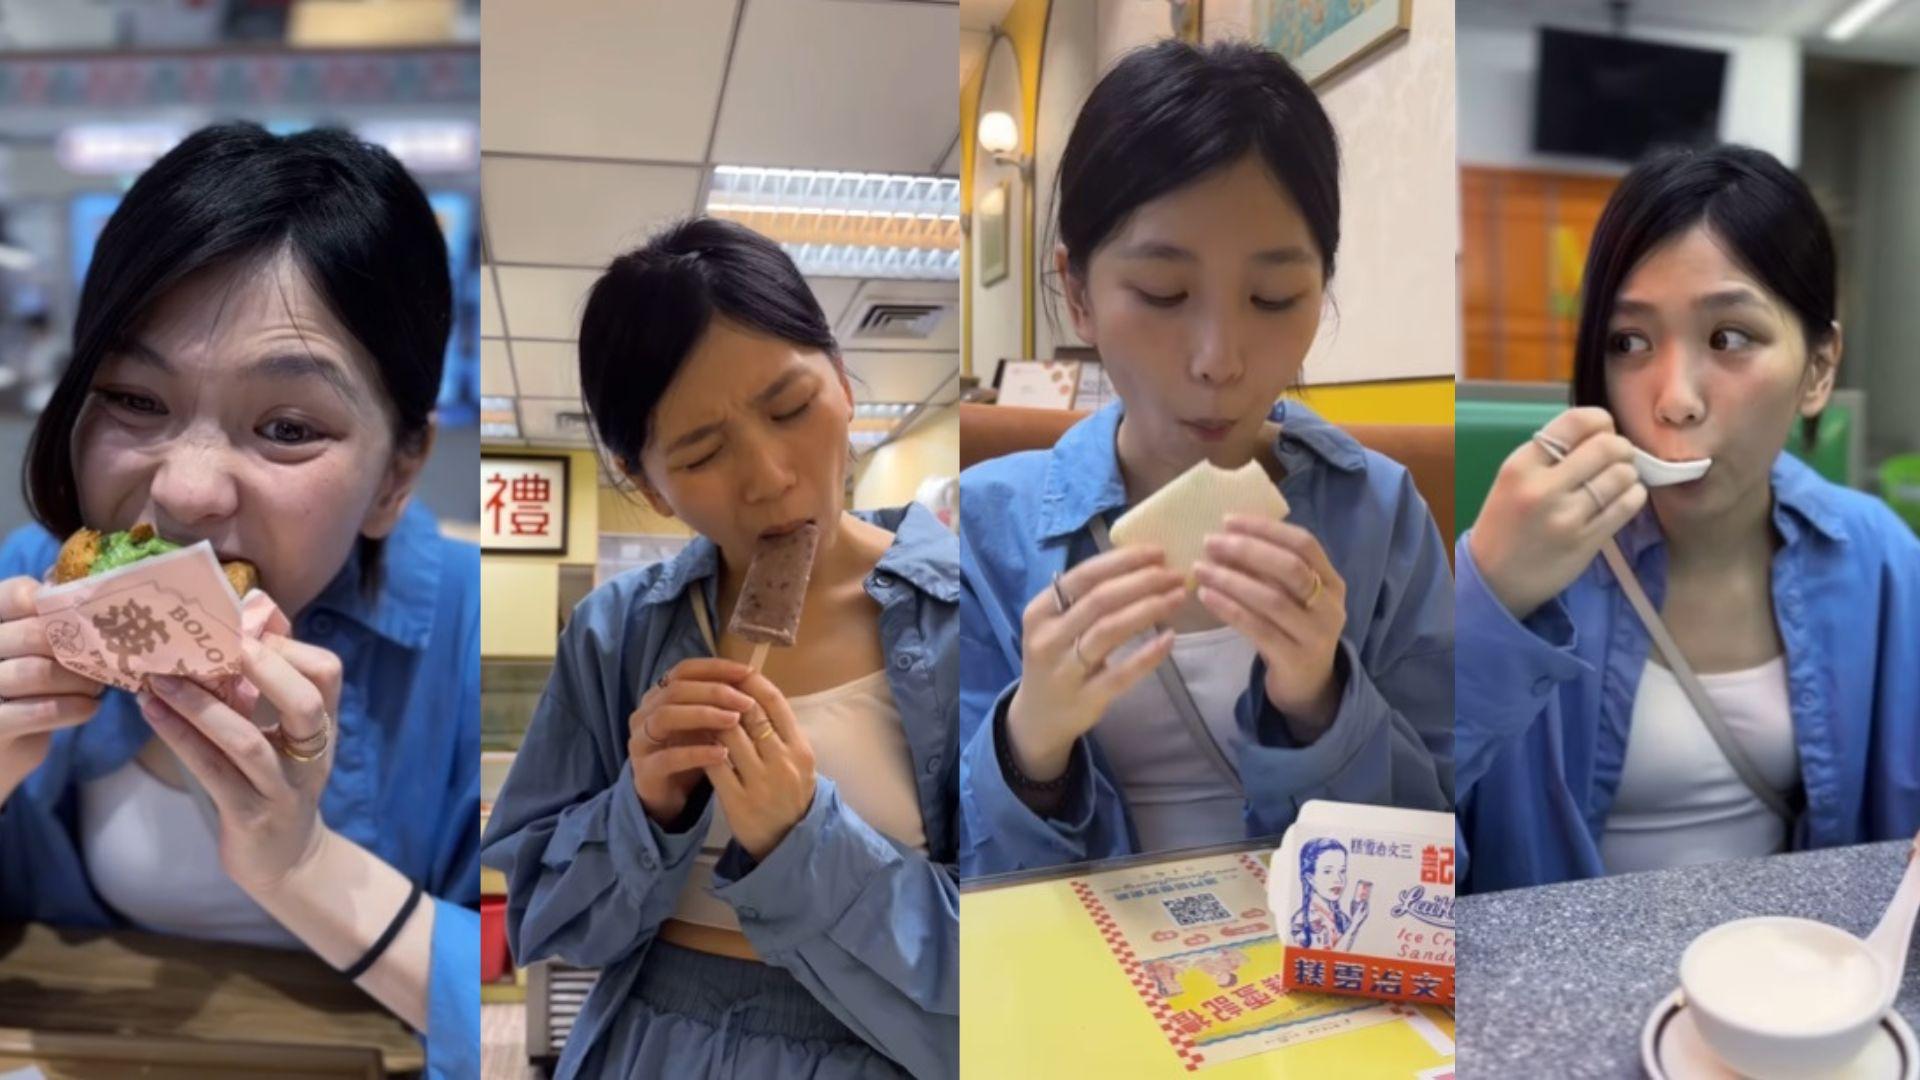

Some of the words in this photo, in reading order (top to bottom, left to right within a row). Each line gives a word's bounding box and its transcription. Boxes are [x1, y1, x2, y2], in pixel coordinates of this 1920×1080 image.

[485, 472, 550, 537] 禮
[167, 605, 226, 663] BOLO
[1420, 844, 1455, 886] 記
[1397, 928, 1424, 945] Ice
[1432, 931, 1455, 947] Cr
